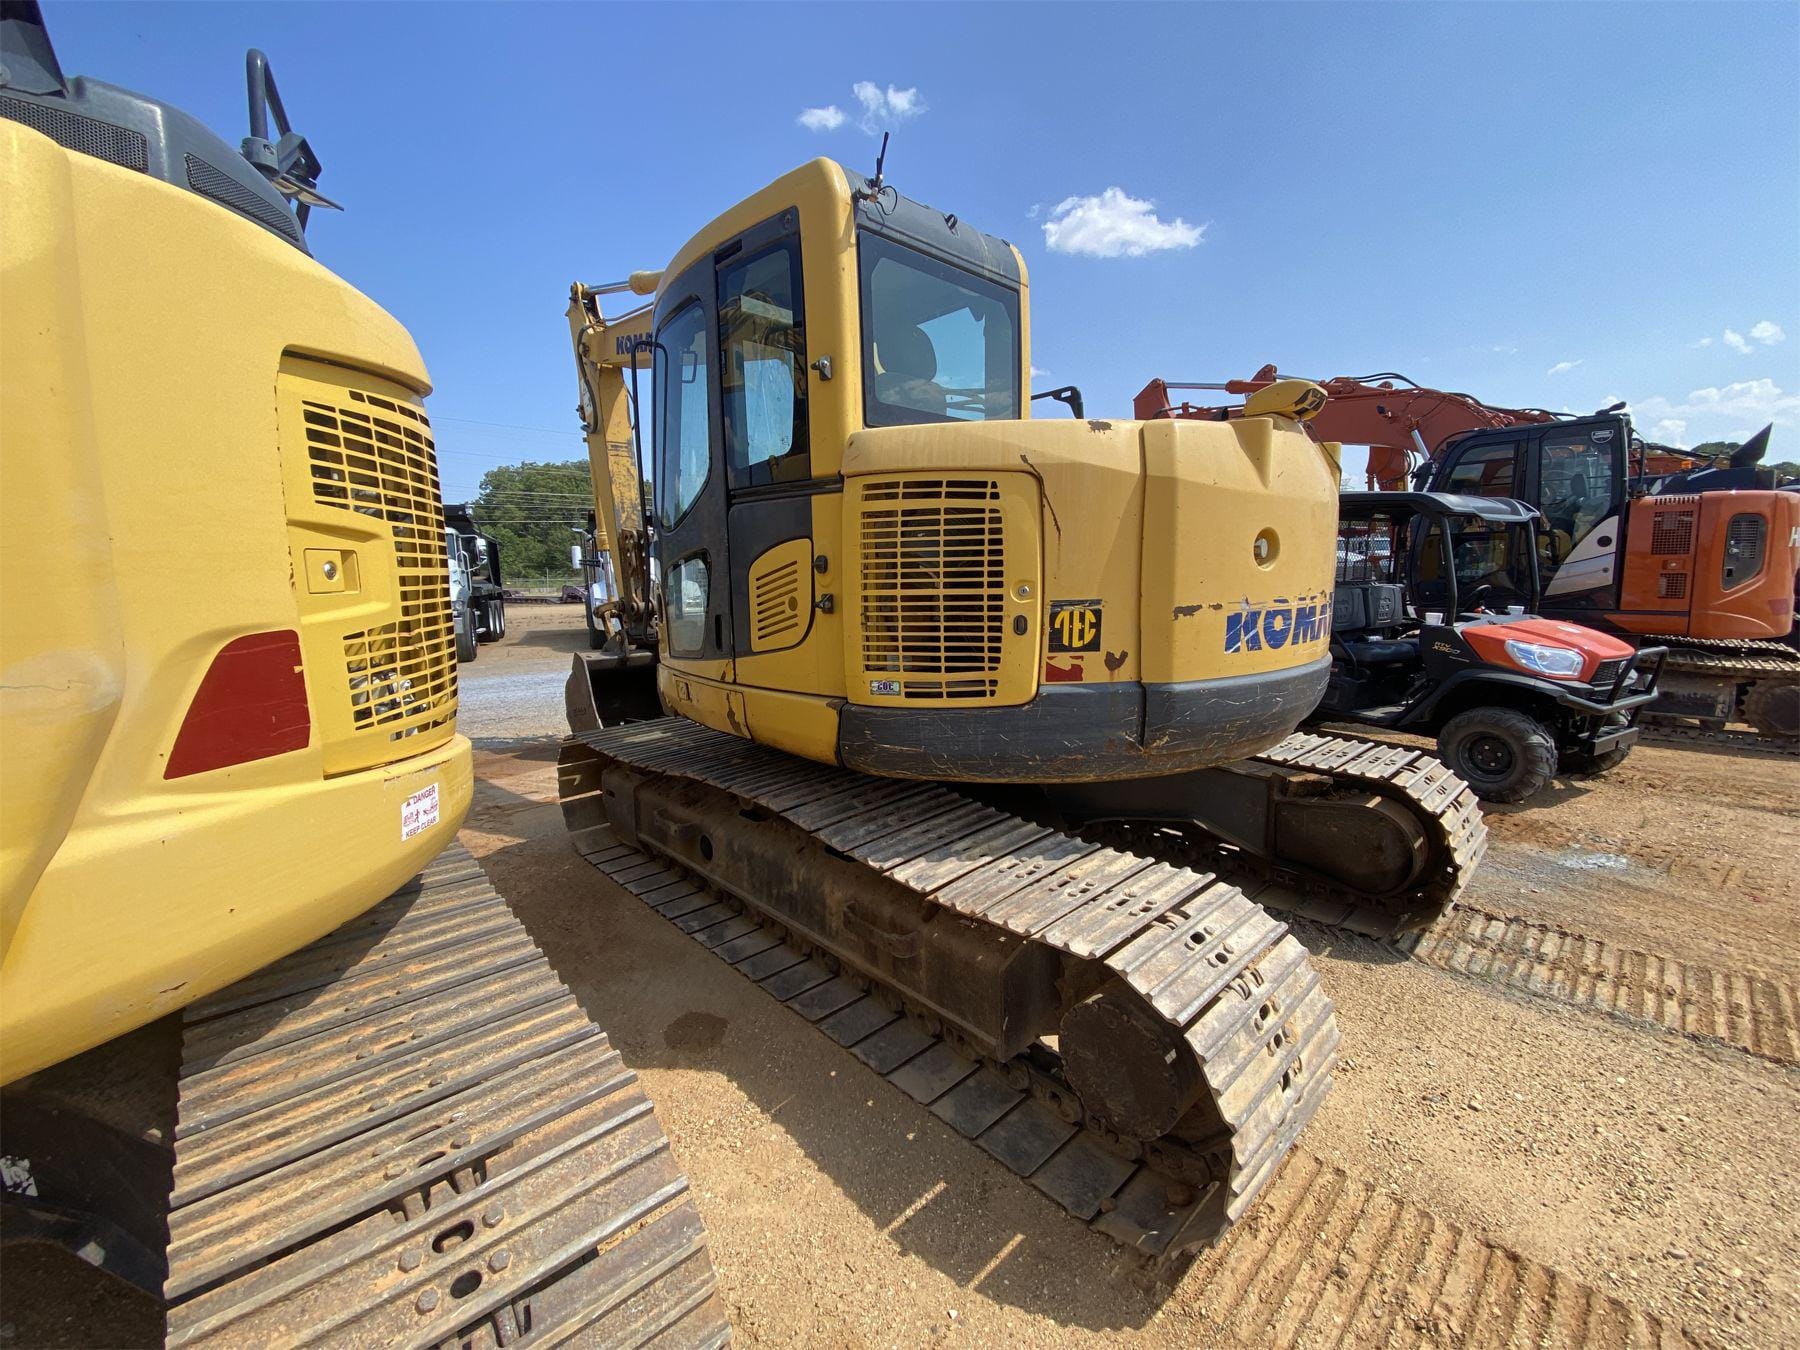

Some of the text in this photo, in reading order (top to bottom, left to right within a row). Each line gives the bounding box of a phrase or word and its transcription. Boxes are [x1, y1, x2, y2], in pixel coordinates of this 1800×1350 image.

[413, 785, 436, 804] DANGER
[405, 816, 436, 839] KEEP CLEAR
